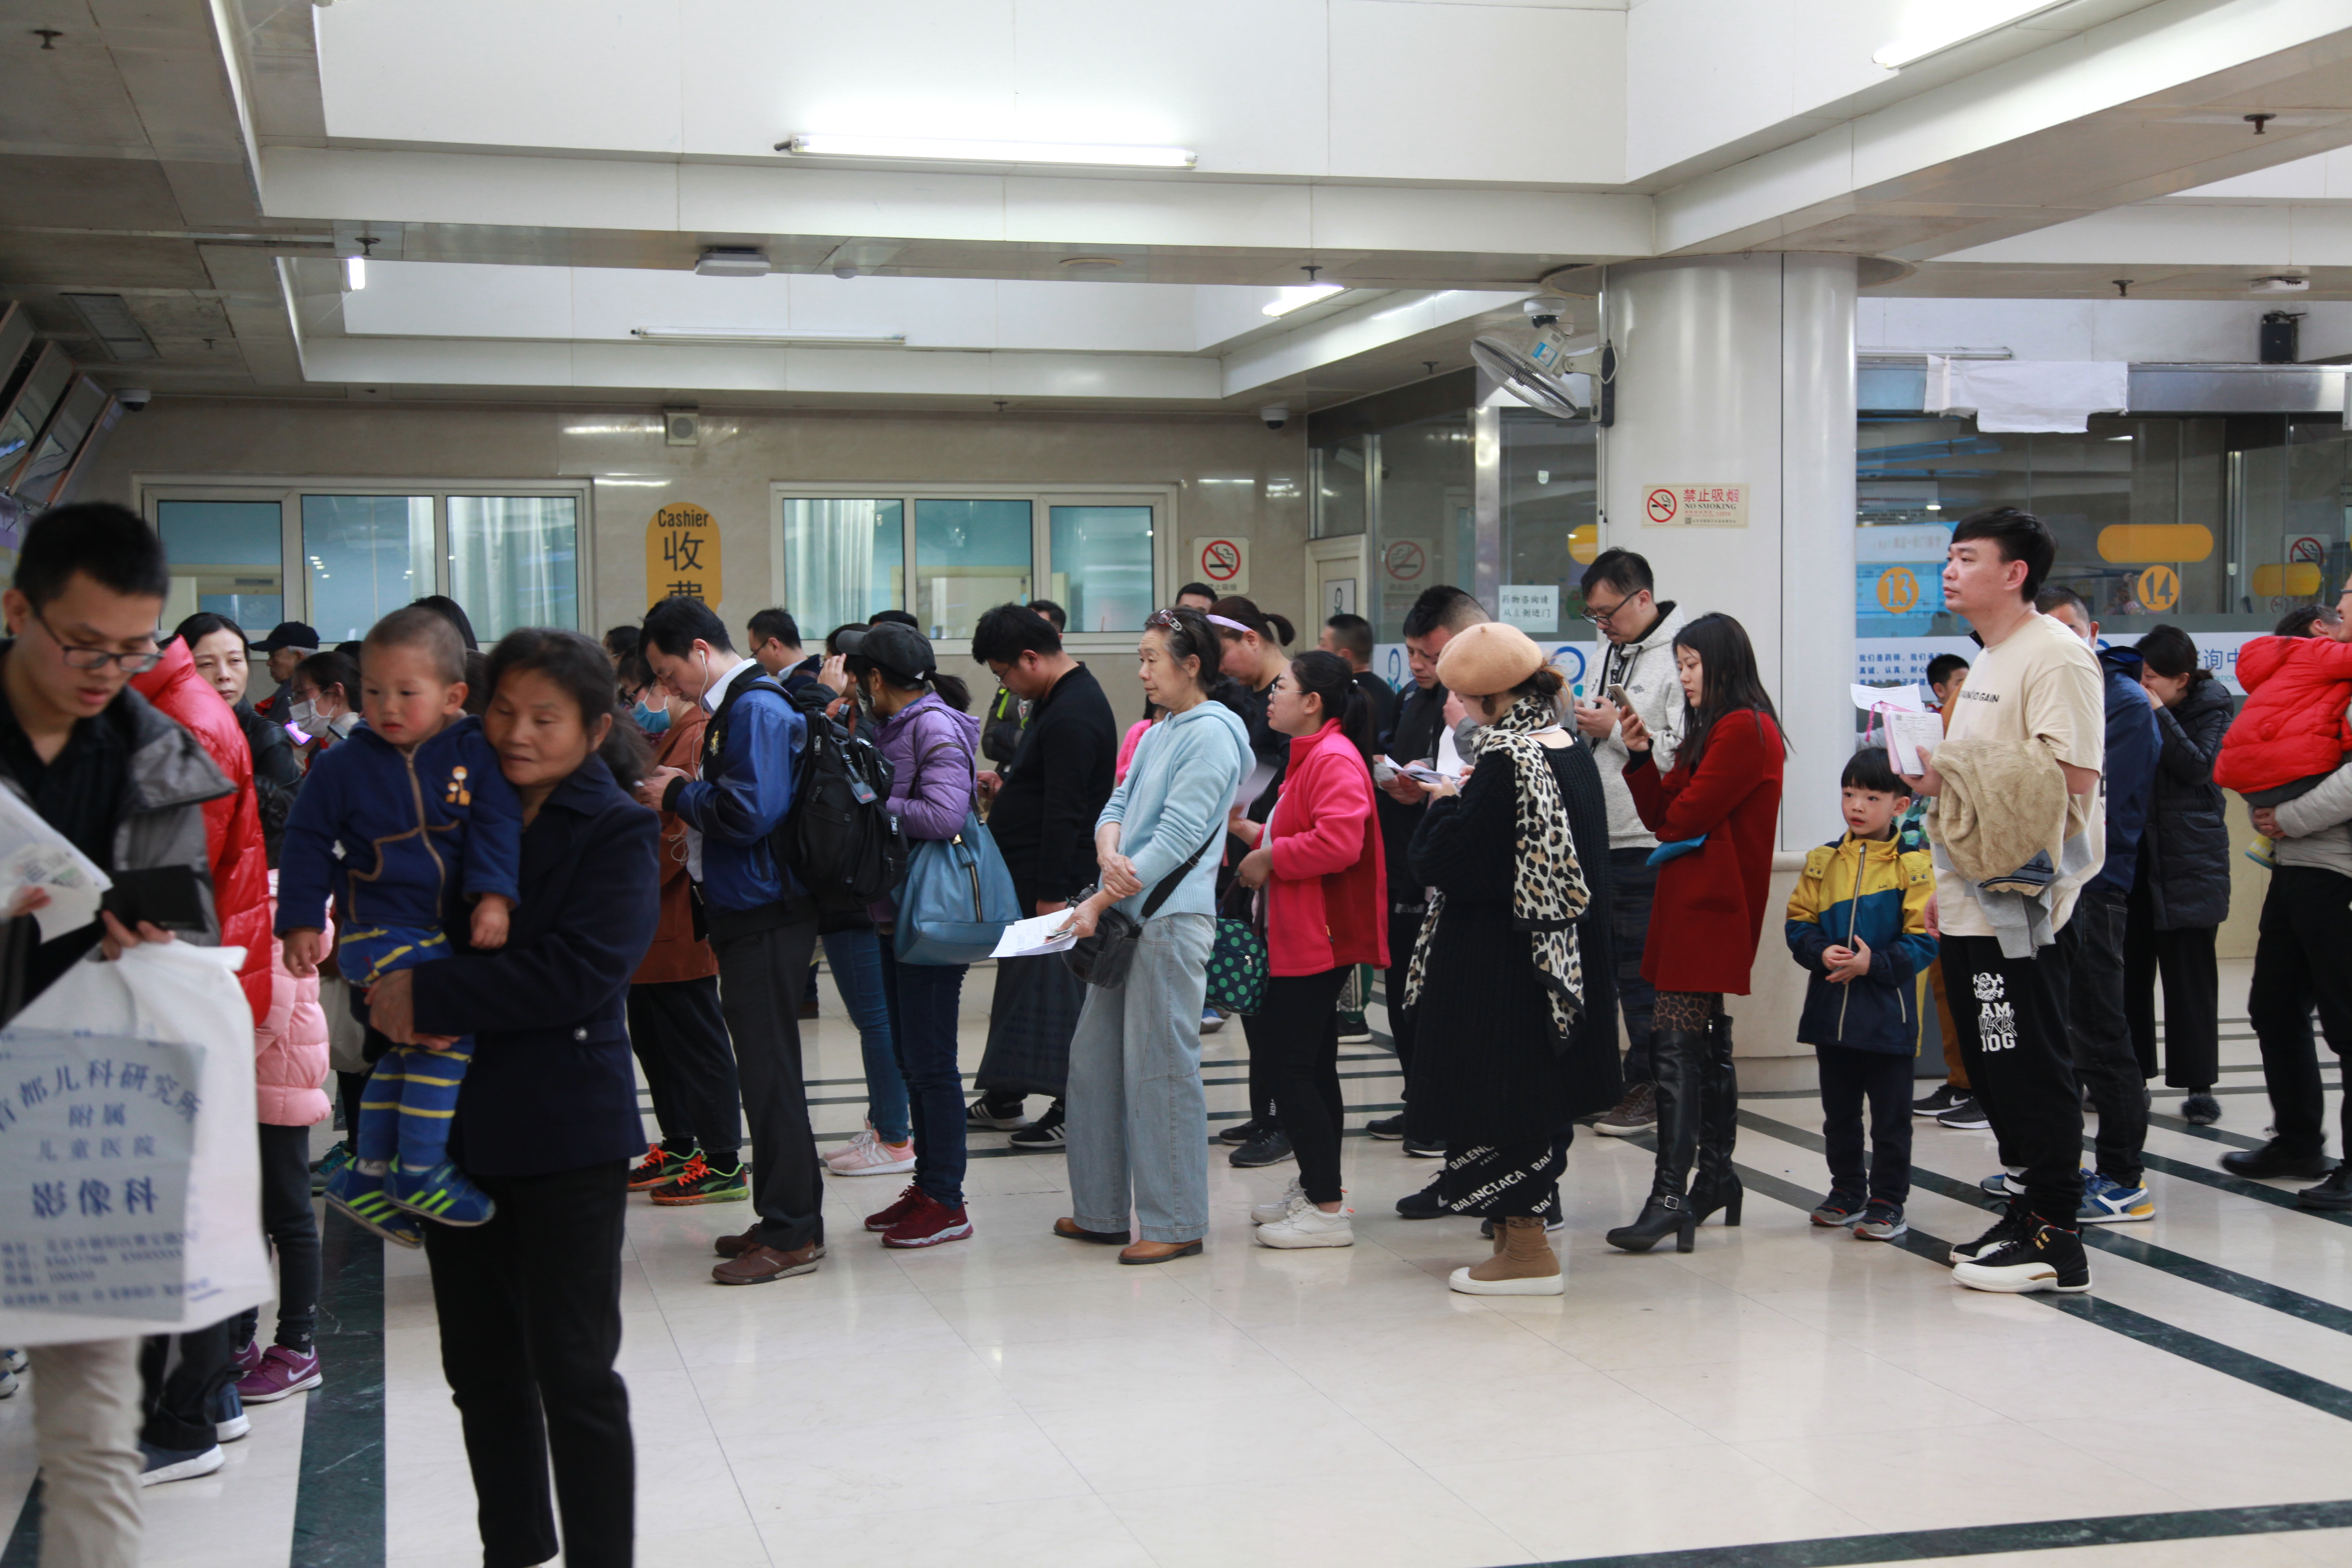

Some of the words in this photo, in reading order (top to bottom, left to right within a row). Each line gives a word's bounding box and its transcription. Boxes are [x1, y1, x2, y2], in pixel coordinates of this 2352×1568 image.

[1683, 488, 1739, 503] 禁止吸烟
[658, 509, 709, 527] Cashier
[1885, 573, 1912, 607] 13
[2146, 572, 2173, 604] 14
[1502, 594, 1549, 604] 药物咨询请
[1504, 608, 1550, 617] 从左侧进门
[2197, 648, 2239, 669] 询中
[1979, 693, 2000, 703] GAIN
[1981, 1002, 2010, 1018] AM
[31, 1175, 158, 1219] 影像科
